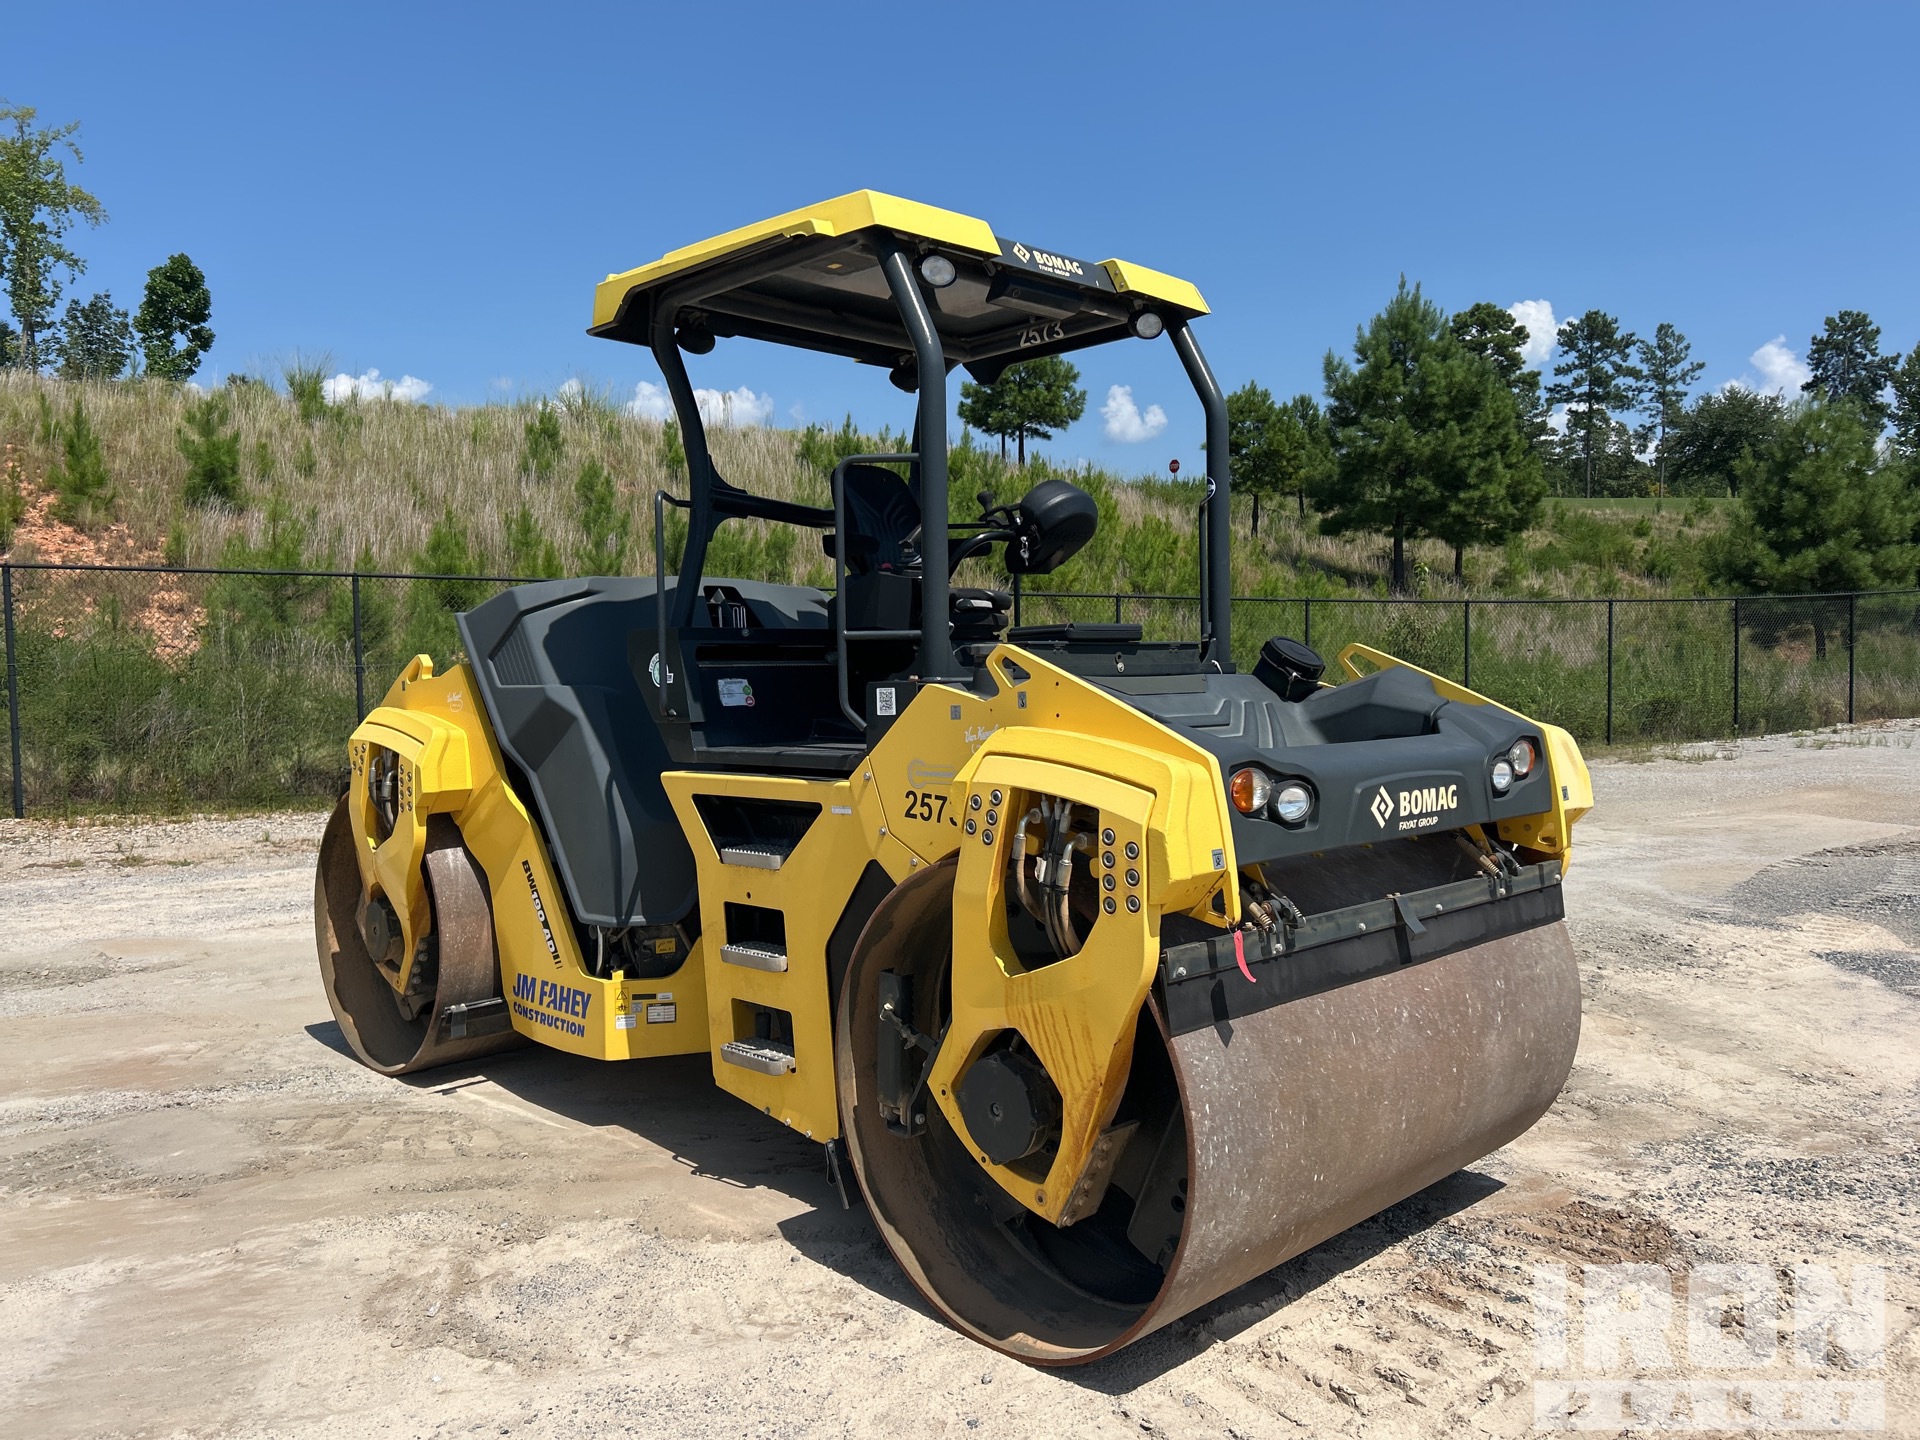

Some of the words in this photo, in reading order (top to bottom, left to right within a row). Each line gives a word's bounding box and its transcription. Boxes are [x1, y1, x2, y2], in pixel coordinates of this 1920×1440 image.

[1033, 250, 1083, 275] BOMAG
[1399, 785, 1458, 816] BOMAG
[1399, 819, 1417, 831] FAYAT
[1418, 816, 1439, 828] GROUP
[513, 973, 537, 1002] JM
[539, 979, 592, 1020] FAHEY
[513, 1001, 585, 1038] CONSTRUCTION
